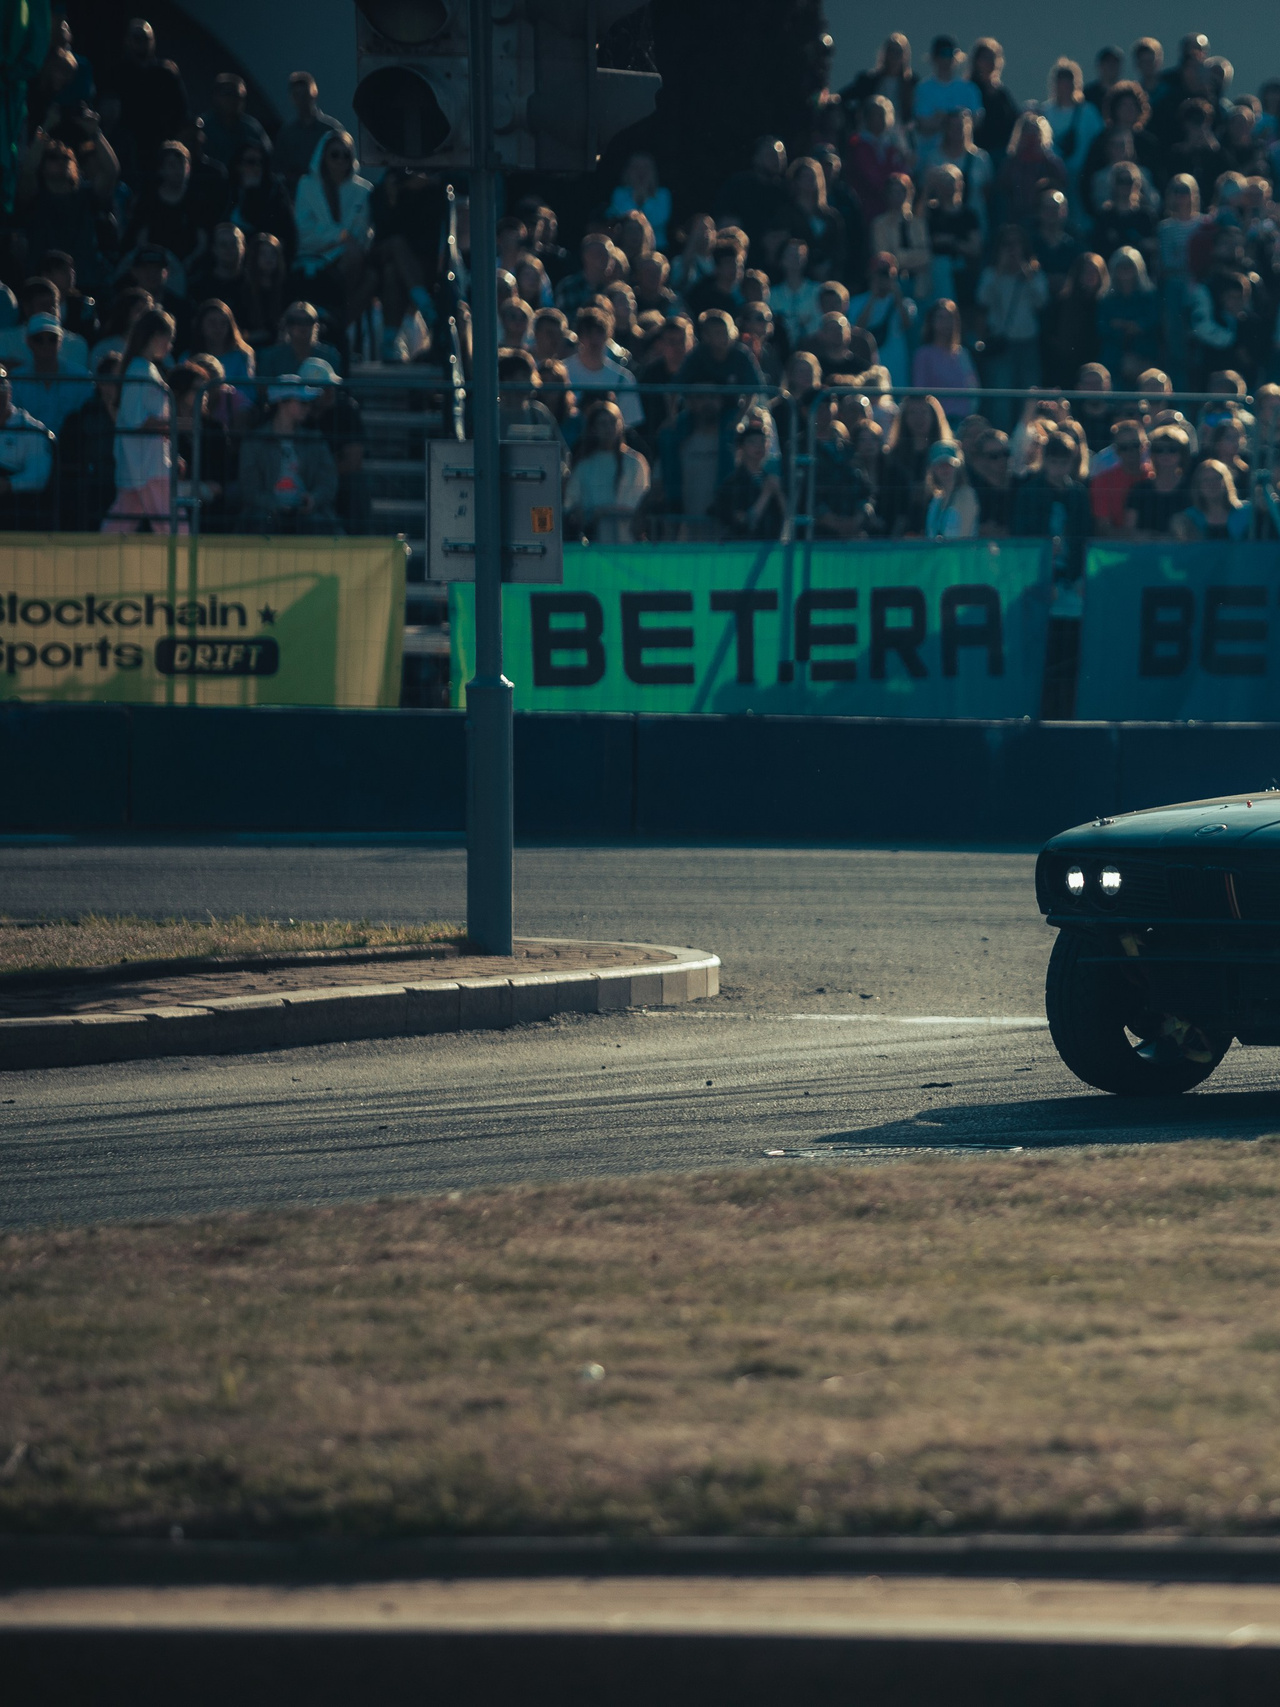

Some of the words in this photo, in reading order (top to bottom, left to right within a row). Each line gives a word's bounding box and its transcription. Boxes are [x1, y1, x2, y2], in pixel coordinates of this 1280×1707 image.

[0, 591, 248, 628] lockchain
[0, 636, 143, 676] ports
[173, 644, 264, 670] DRIFT
